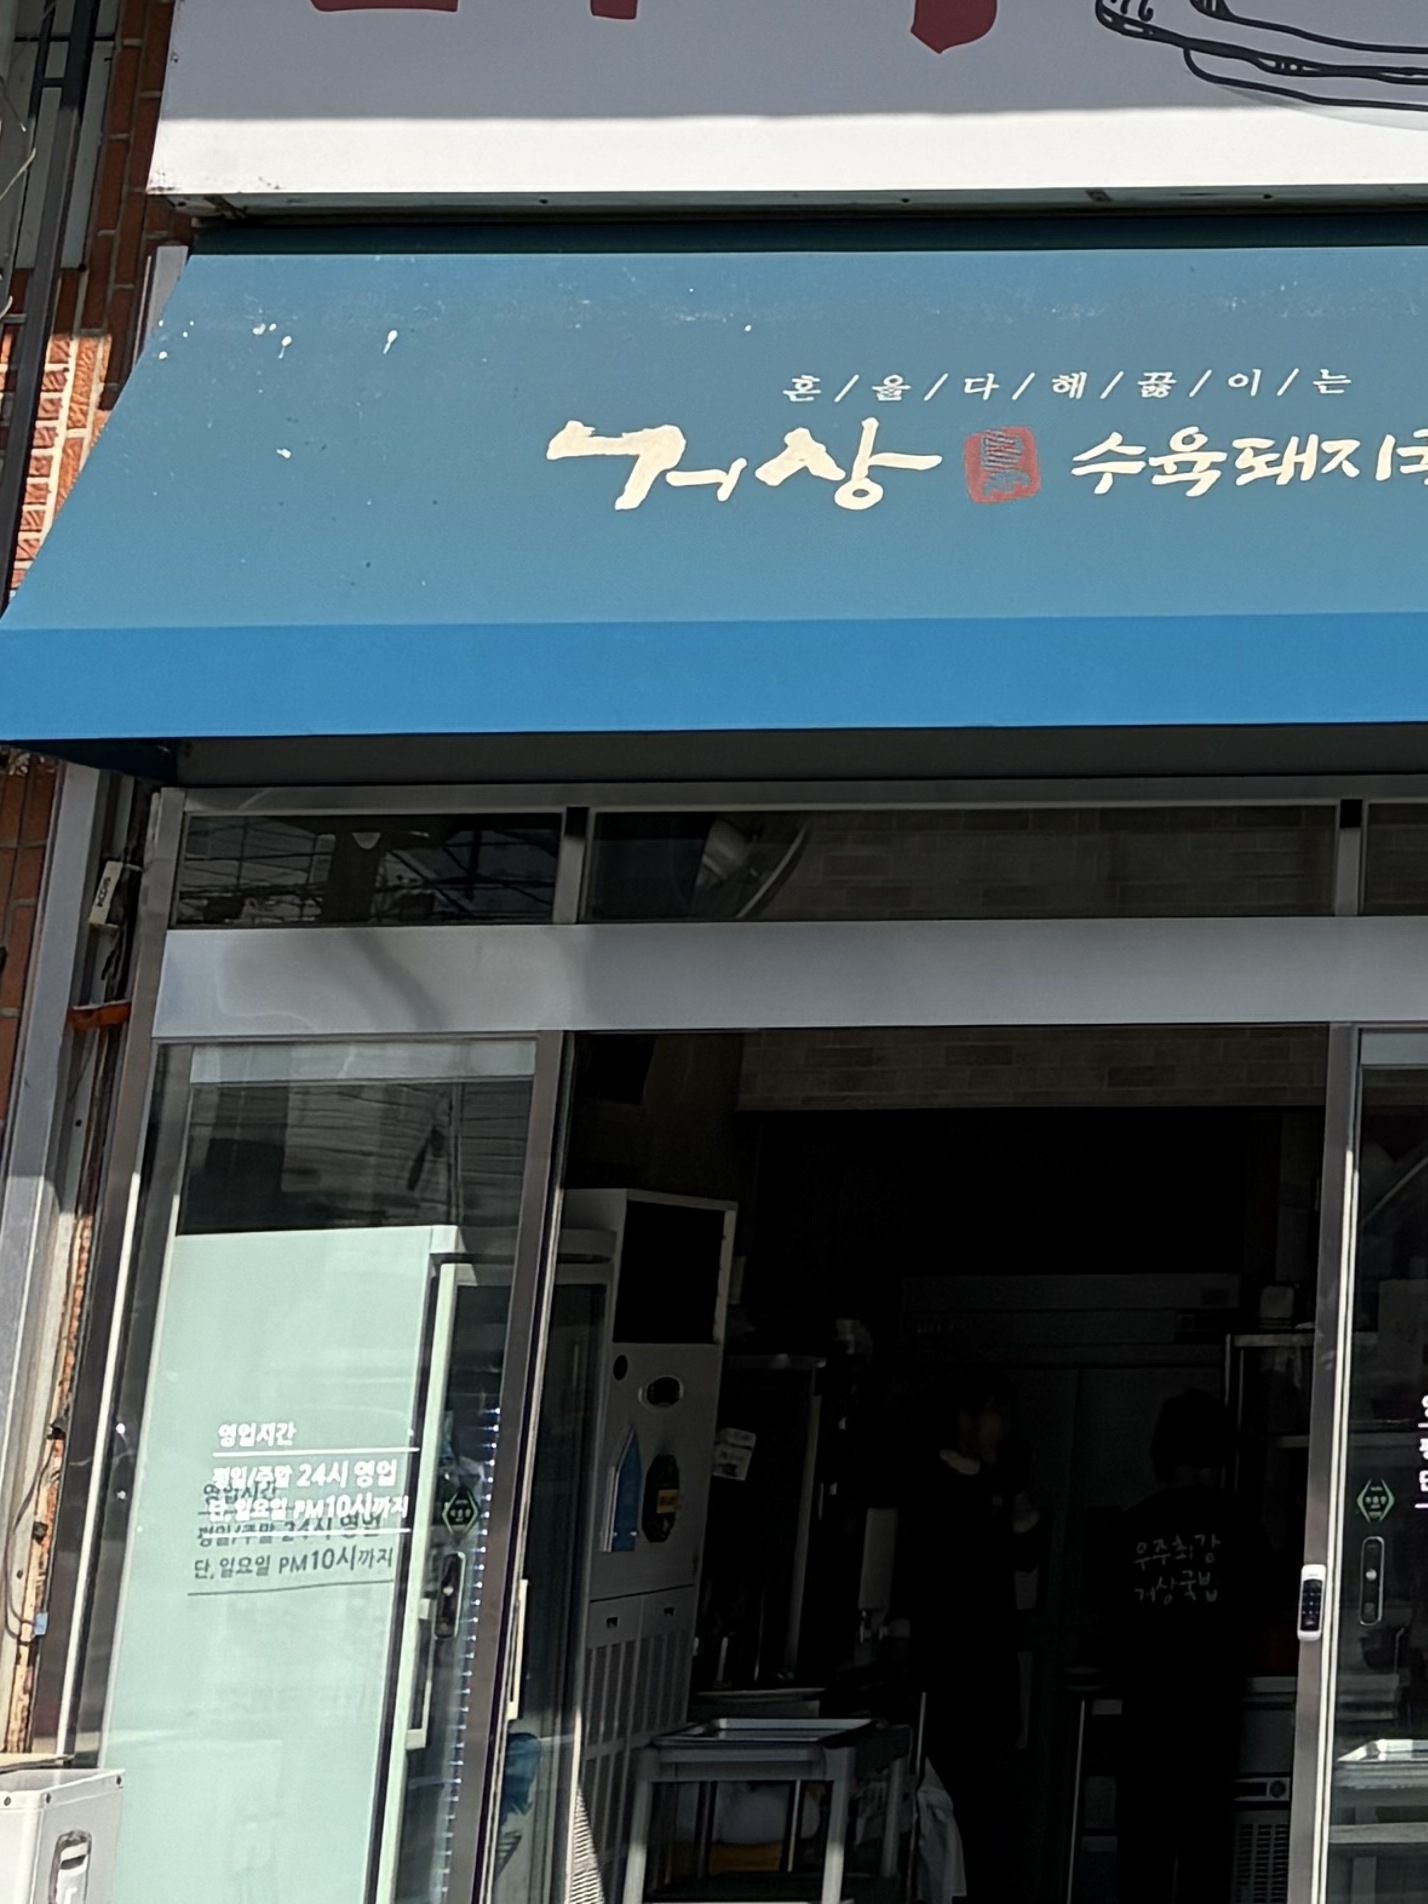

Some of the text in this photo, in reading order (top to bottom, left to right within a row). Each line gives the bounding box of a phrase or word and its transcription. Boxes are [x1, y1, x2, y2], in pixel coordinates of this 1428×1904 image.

[547, 417, 943, 510] 거상
[218, 1421, 297, 1447] 영업시간
[296, 1460, 349, 1488] 24시
[354, 1459, 398, 1488] 영업
